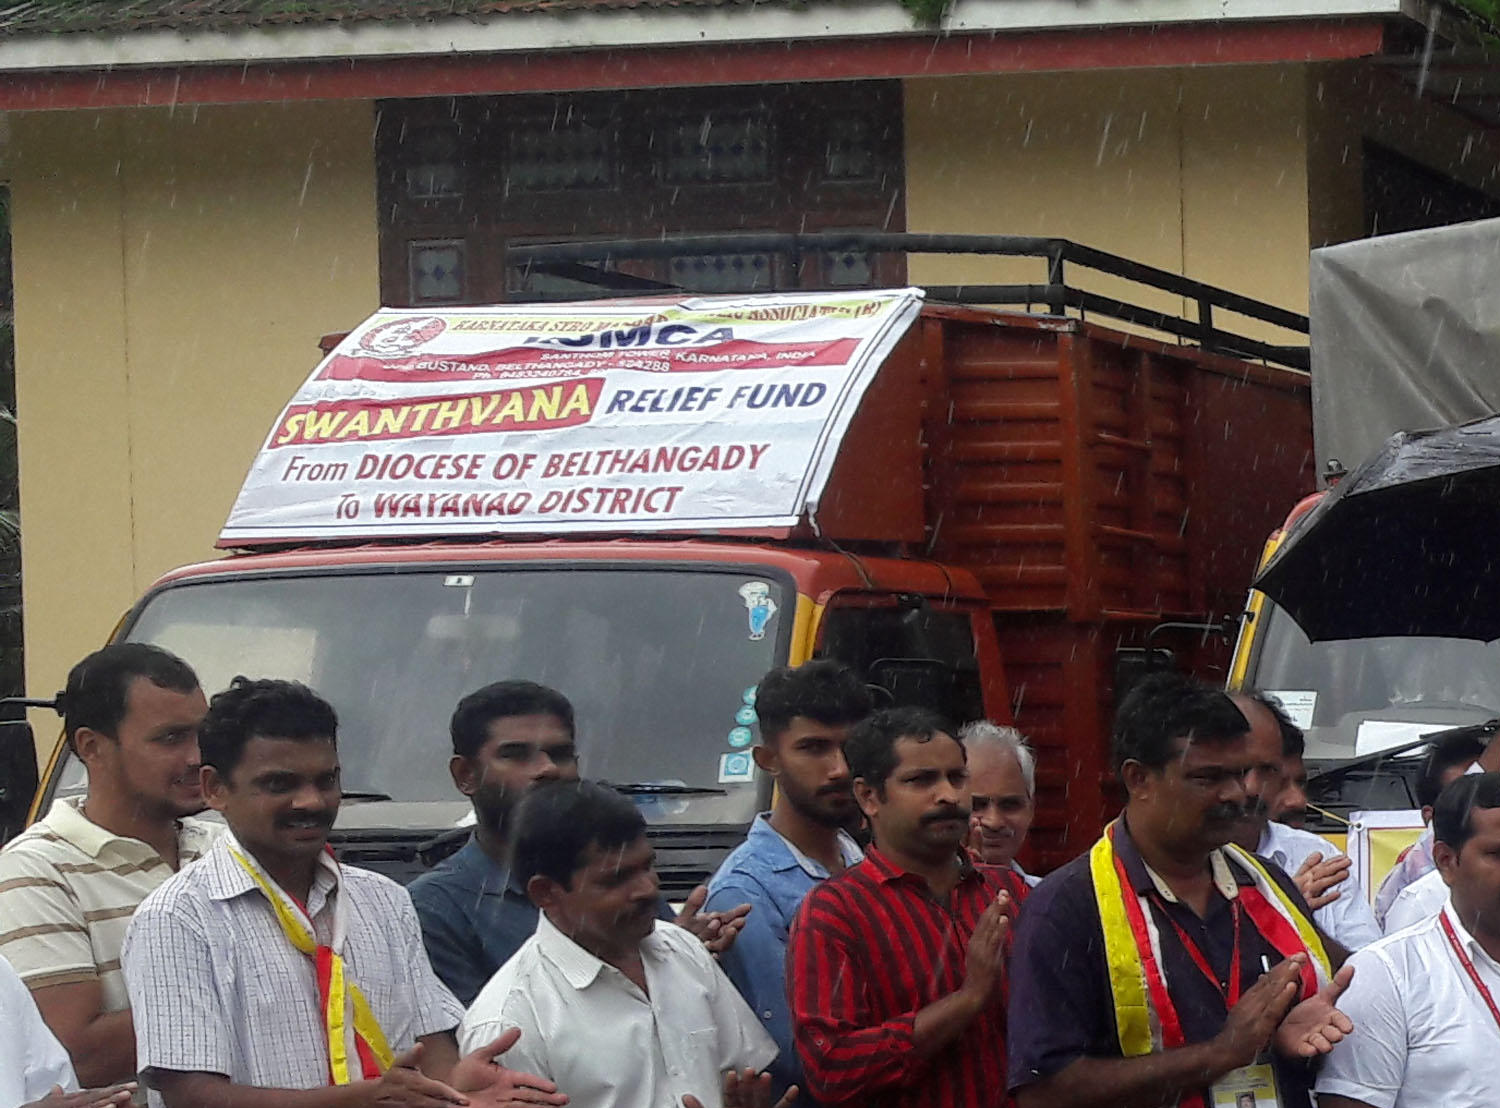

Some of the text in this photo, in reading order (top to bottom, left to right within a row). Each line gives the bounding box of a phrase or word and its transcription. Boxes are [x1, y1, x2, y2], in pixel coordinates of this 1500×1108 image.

[277, 383, 828, 445] SWANTHVANA RELIEF FUND
[282, 443, 772, 482] From DIOCESE OF BELTHANGADY
[336, 486, 684, 519] To WAYANAD DISTRICT
